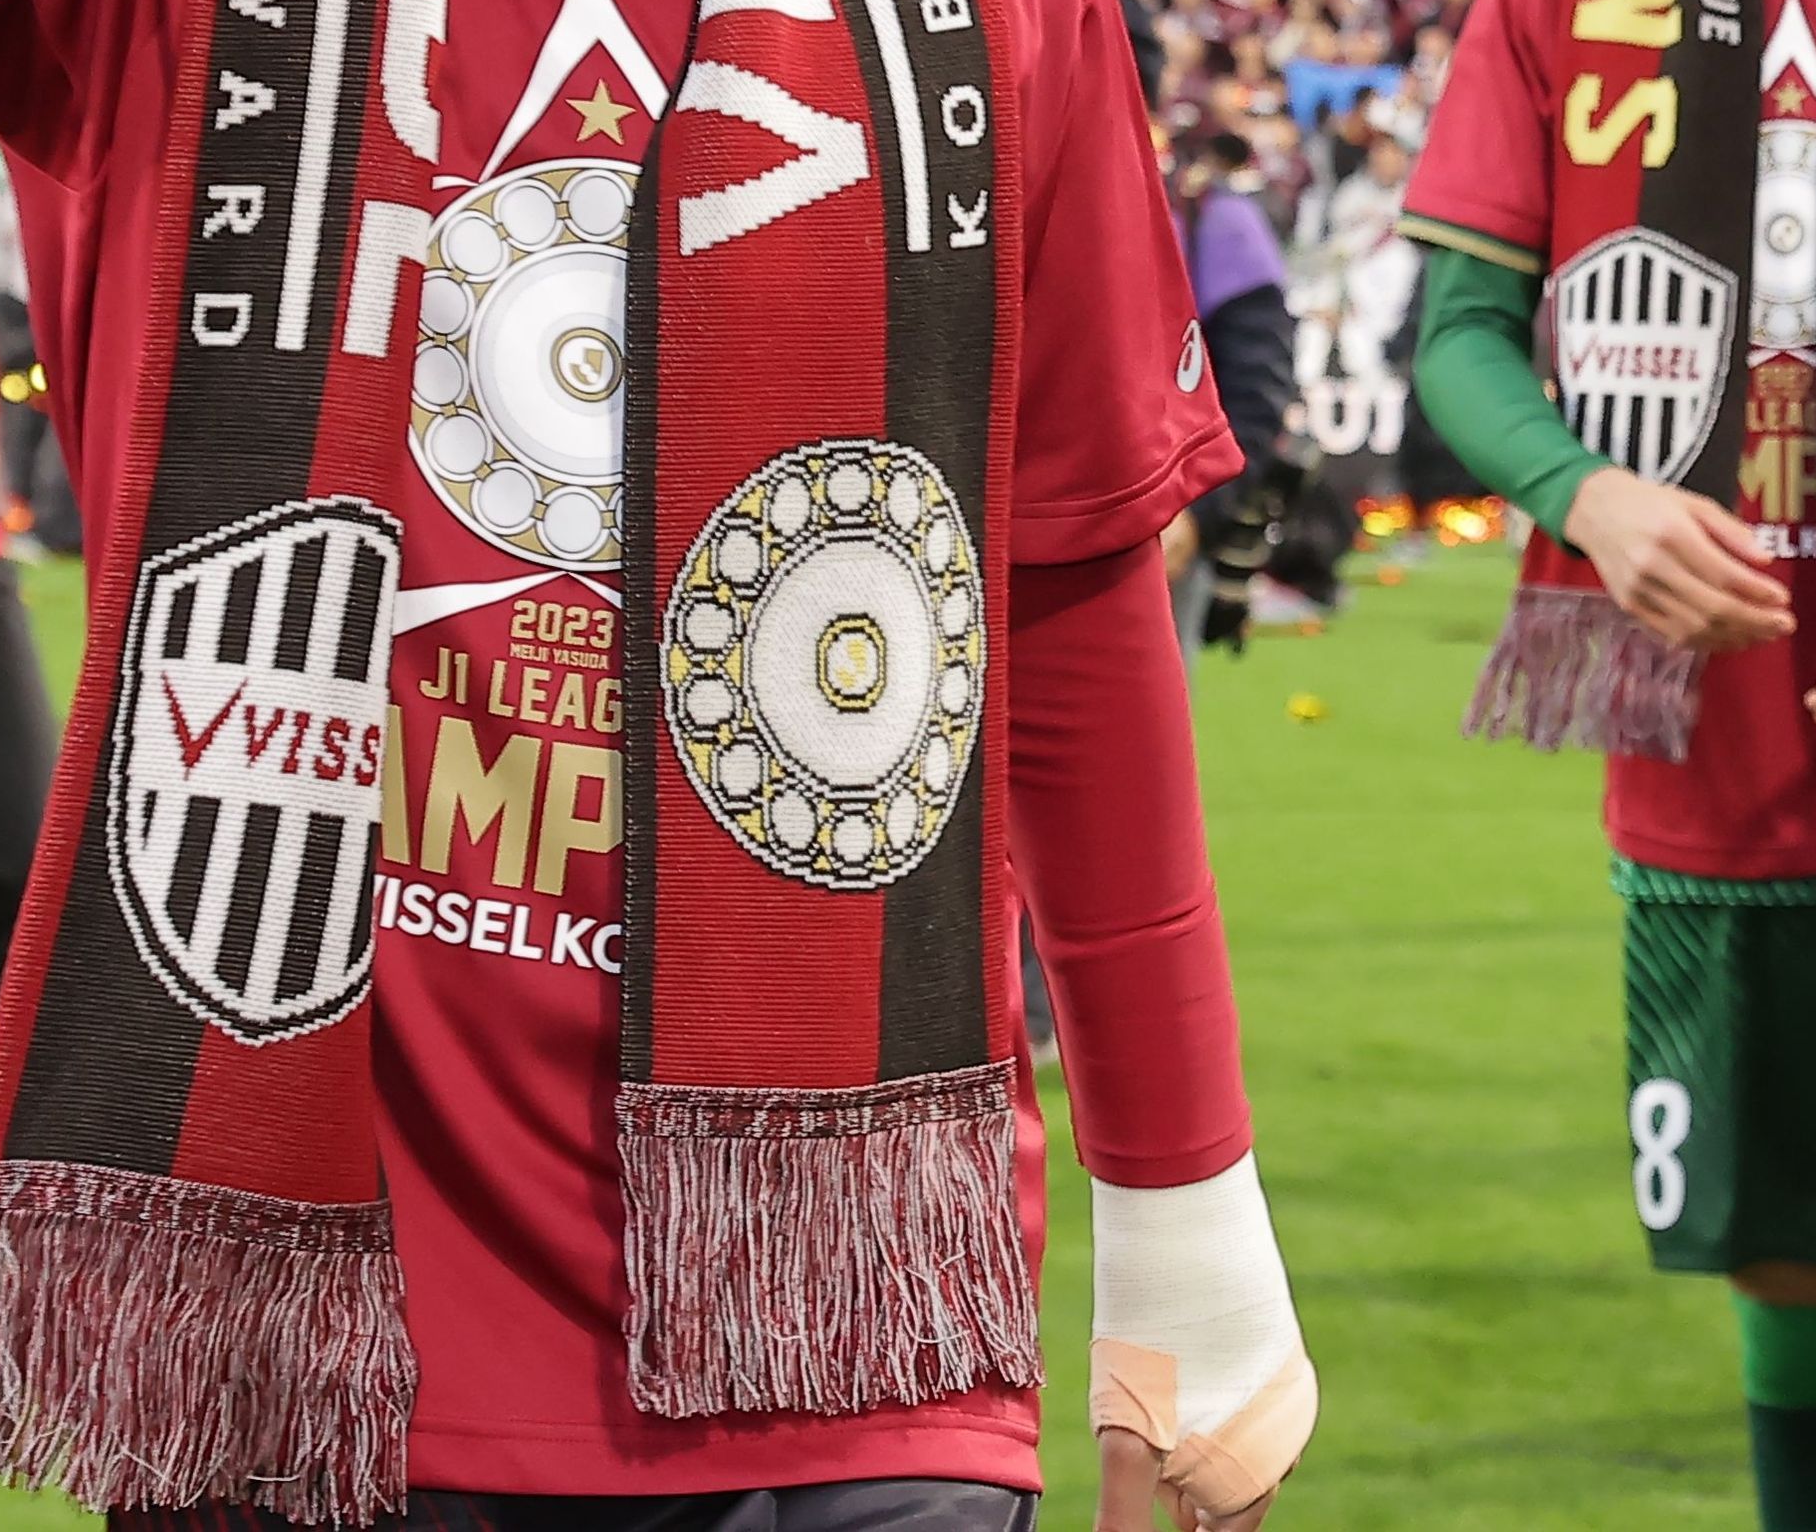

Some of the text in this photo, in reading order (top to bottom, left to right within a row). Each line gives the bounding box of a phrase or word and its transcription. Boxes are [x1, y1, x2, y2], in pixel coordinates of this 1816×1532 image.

[510, 599, 615, 650] 2023
[418, 646, 470, 706] J1
[509, 641, 610, 671] MEIJI YASUDA
[1628, 1076, 1694, 1231] 8
